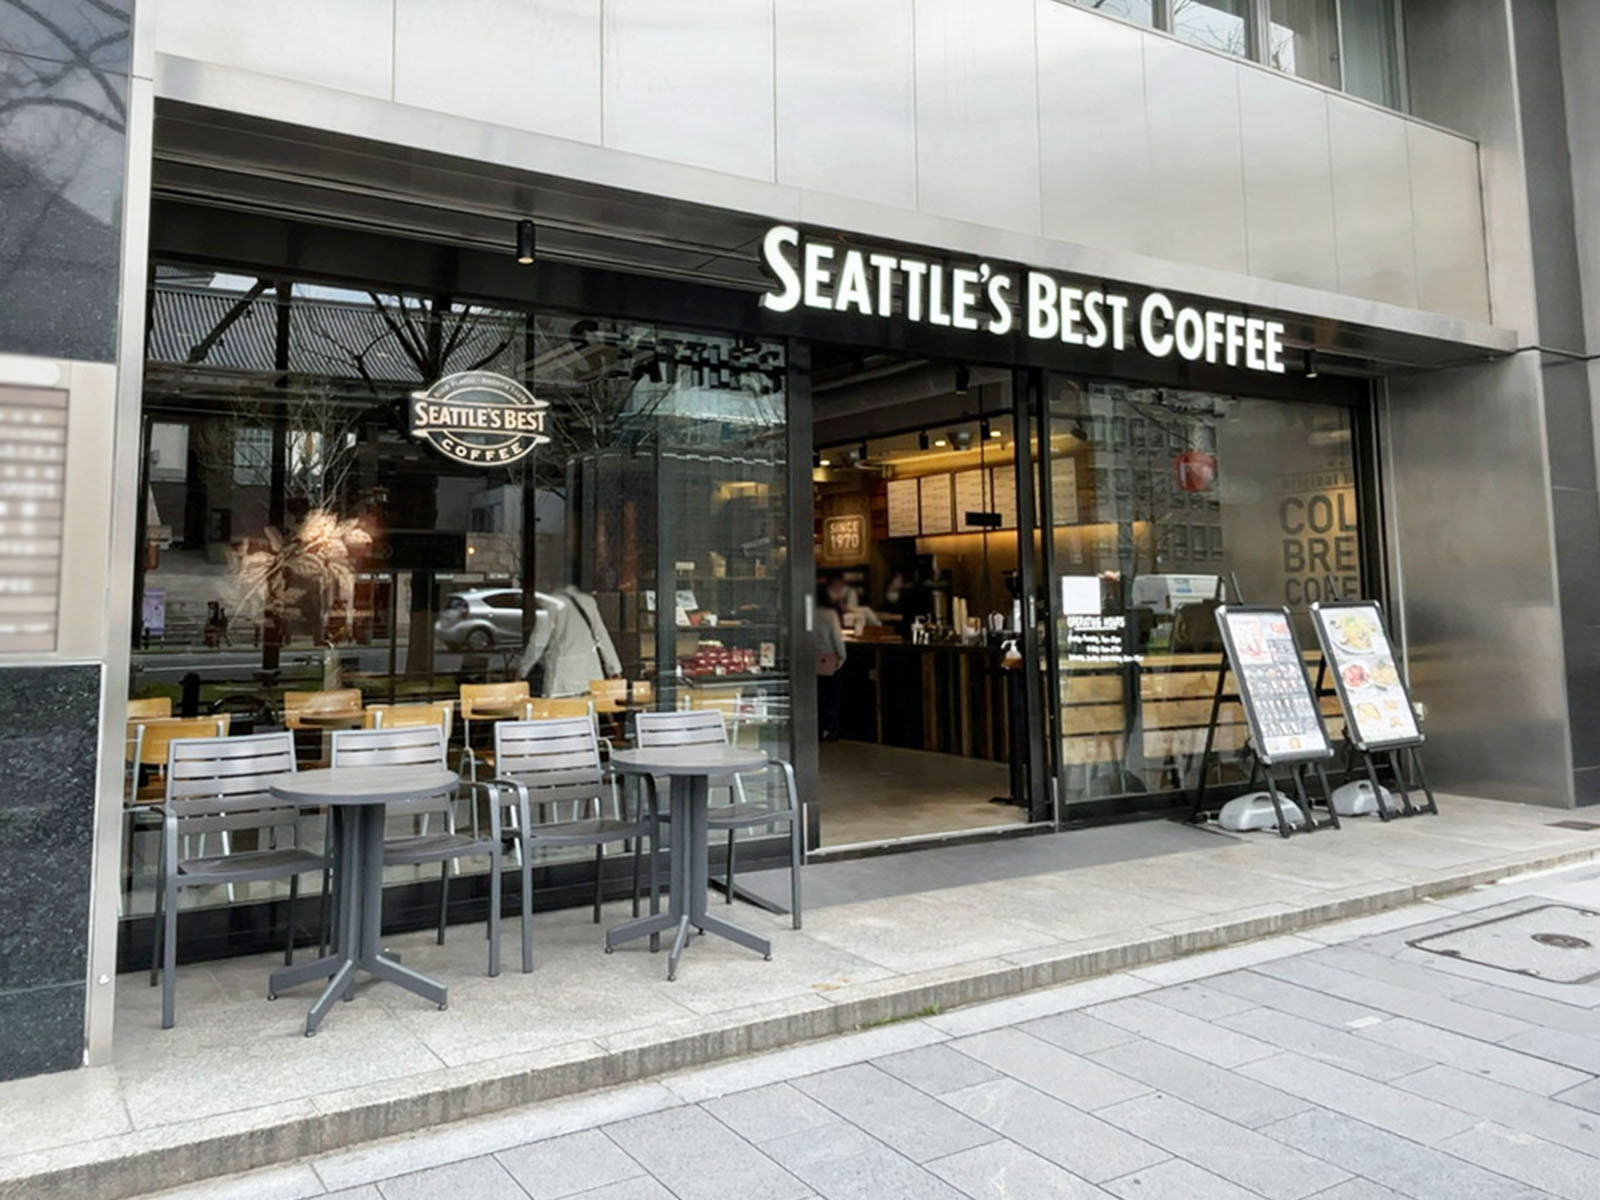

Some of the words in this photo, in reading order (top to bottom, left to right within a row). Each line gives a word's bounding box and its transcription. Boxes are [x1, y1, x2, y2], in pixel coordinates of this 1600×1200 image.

[761, 225, 1012, 335] SEATTLE'S
[1027, 271, 1128, 350] BEST
[1140, 292, 1285, 374] COFFEE
[415, 401, 501, 429] SEATTLE'S
[504, 409, 546, 432] BEST
[441, 438, 524, 462] COFFEE
[830, 520, 859, 534] SINCE
[1280, 492, 1357, 535] COL
[830, 533, 860, 550] 1970
[1282, 535, 1357, 573] BRE
